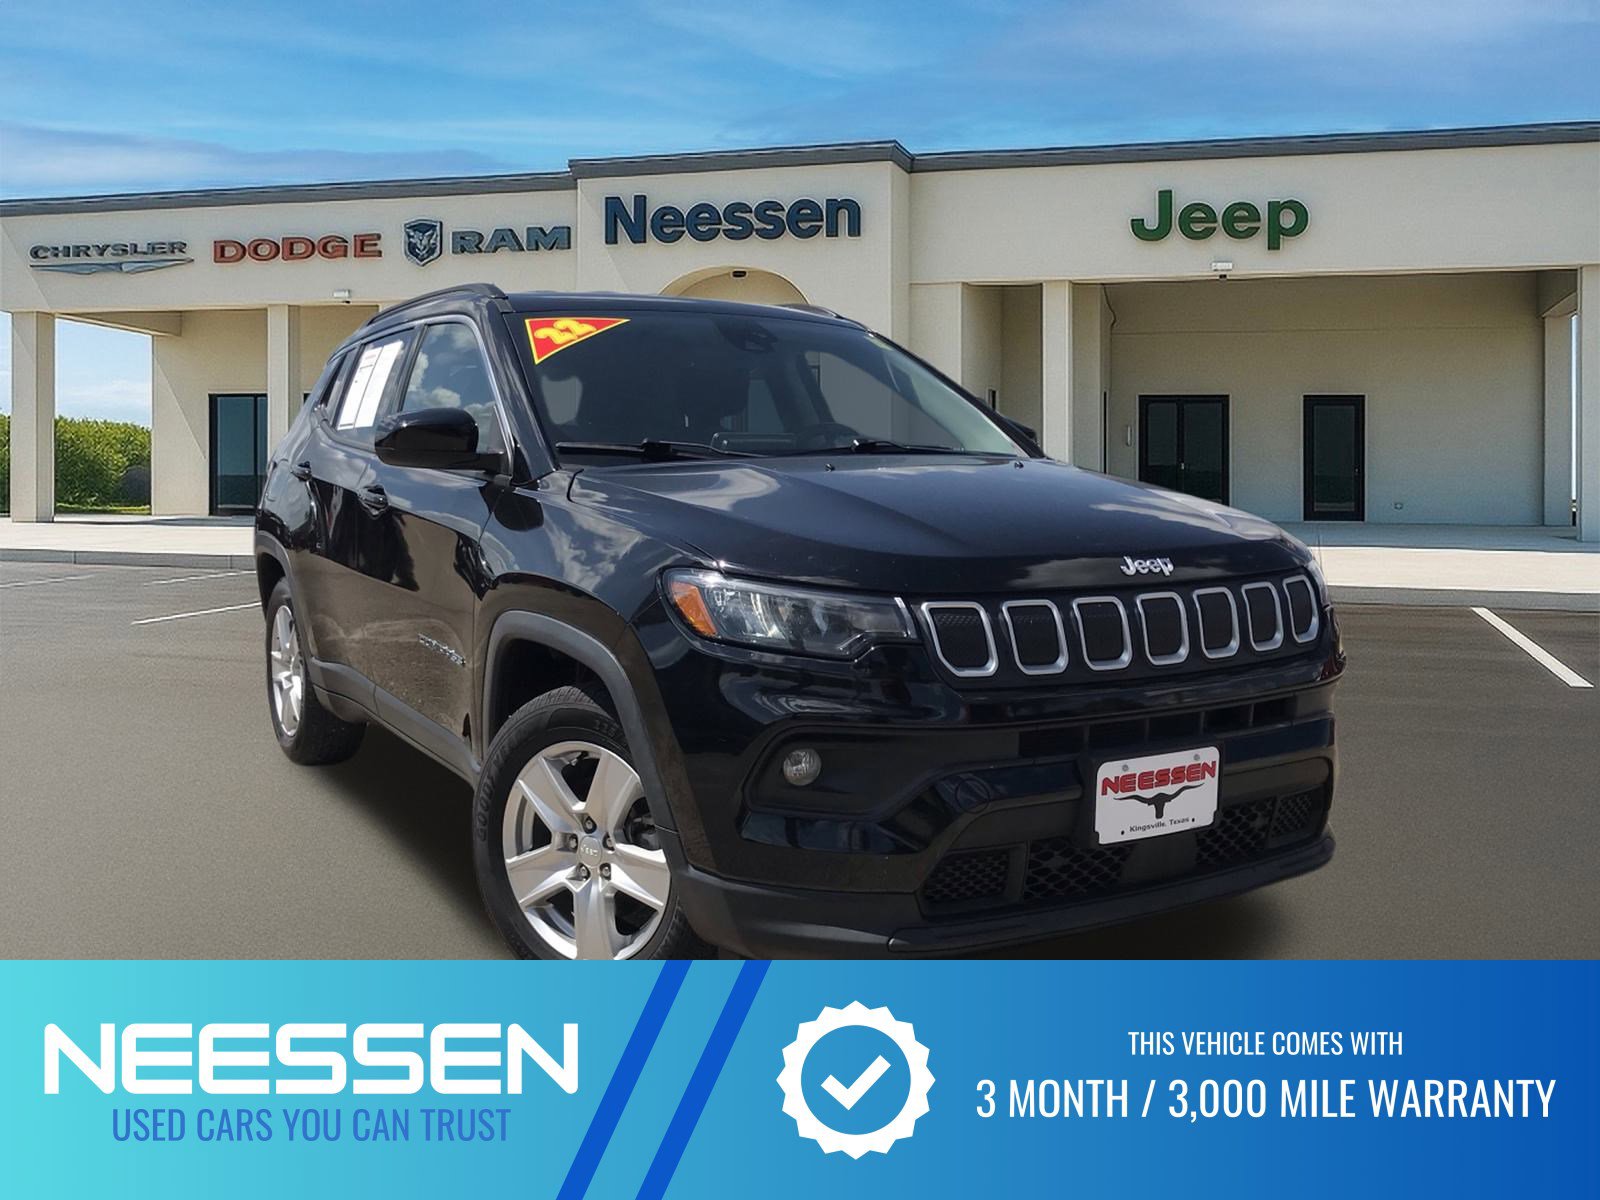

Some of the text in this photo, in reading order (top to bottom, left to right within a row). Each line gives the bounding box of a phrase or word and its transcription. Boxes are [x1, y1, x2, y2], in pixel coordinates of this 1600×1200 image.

[604, 194, 862, 245] Neessen
[1130, 189, 1309, 251] Jeep
[29, 240, 188, 260] CHRYSLER
[213, 233, 382, 263] DODGE
[451, 226, 571, 254] RAM
[533, 319, 597, 345] 22
[1120, 555, 1174, 577] Jeep
[1101, 760, 1217, 796] NEESSEN
[1169, 817, 1190, 826] Texas
